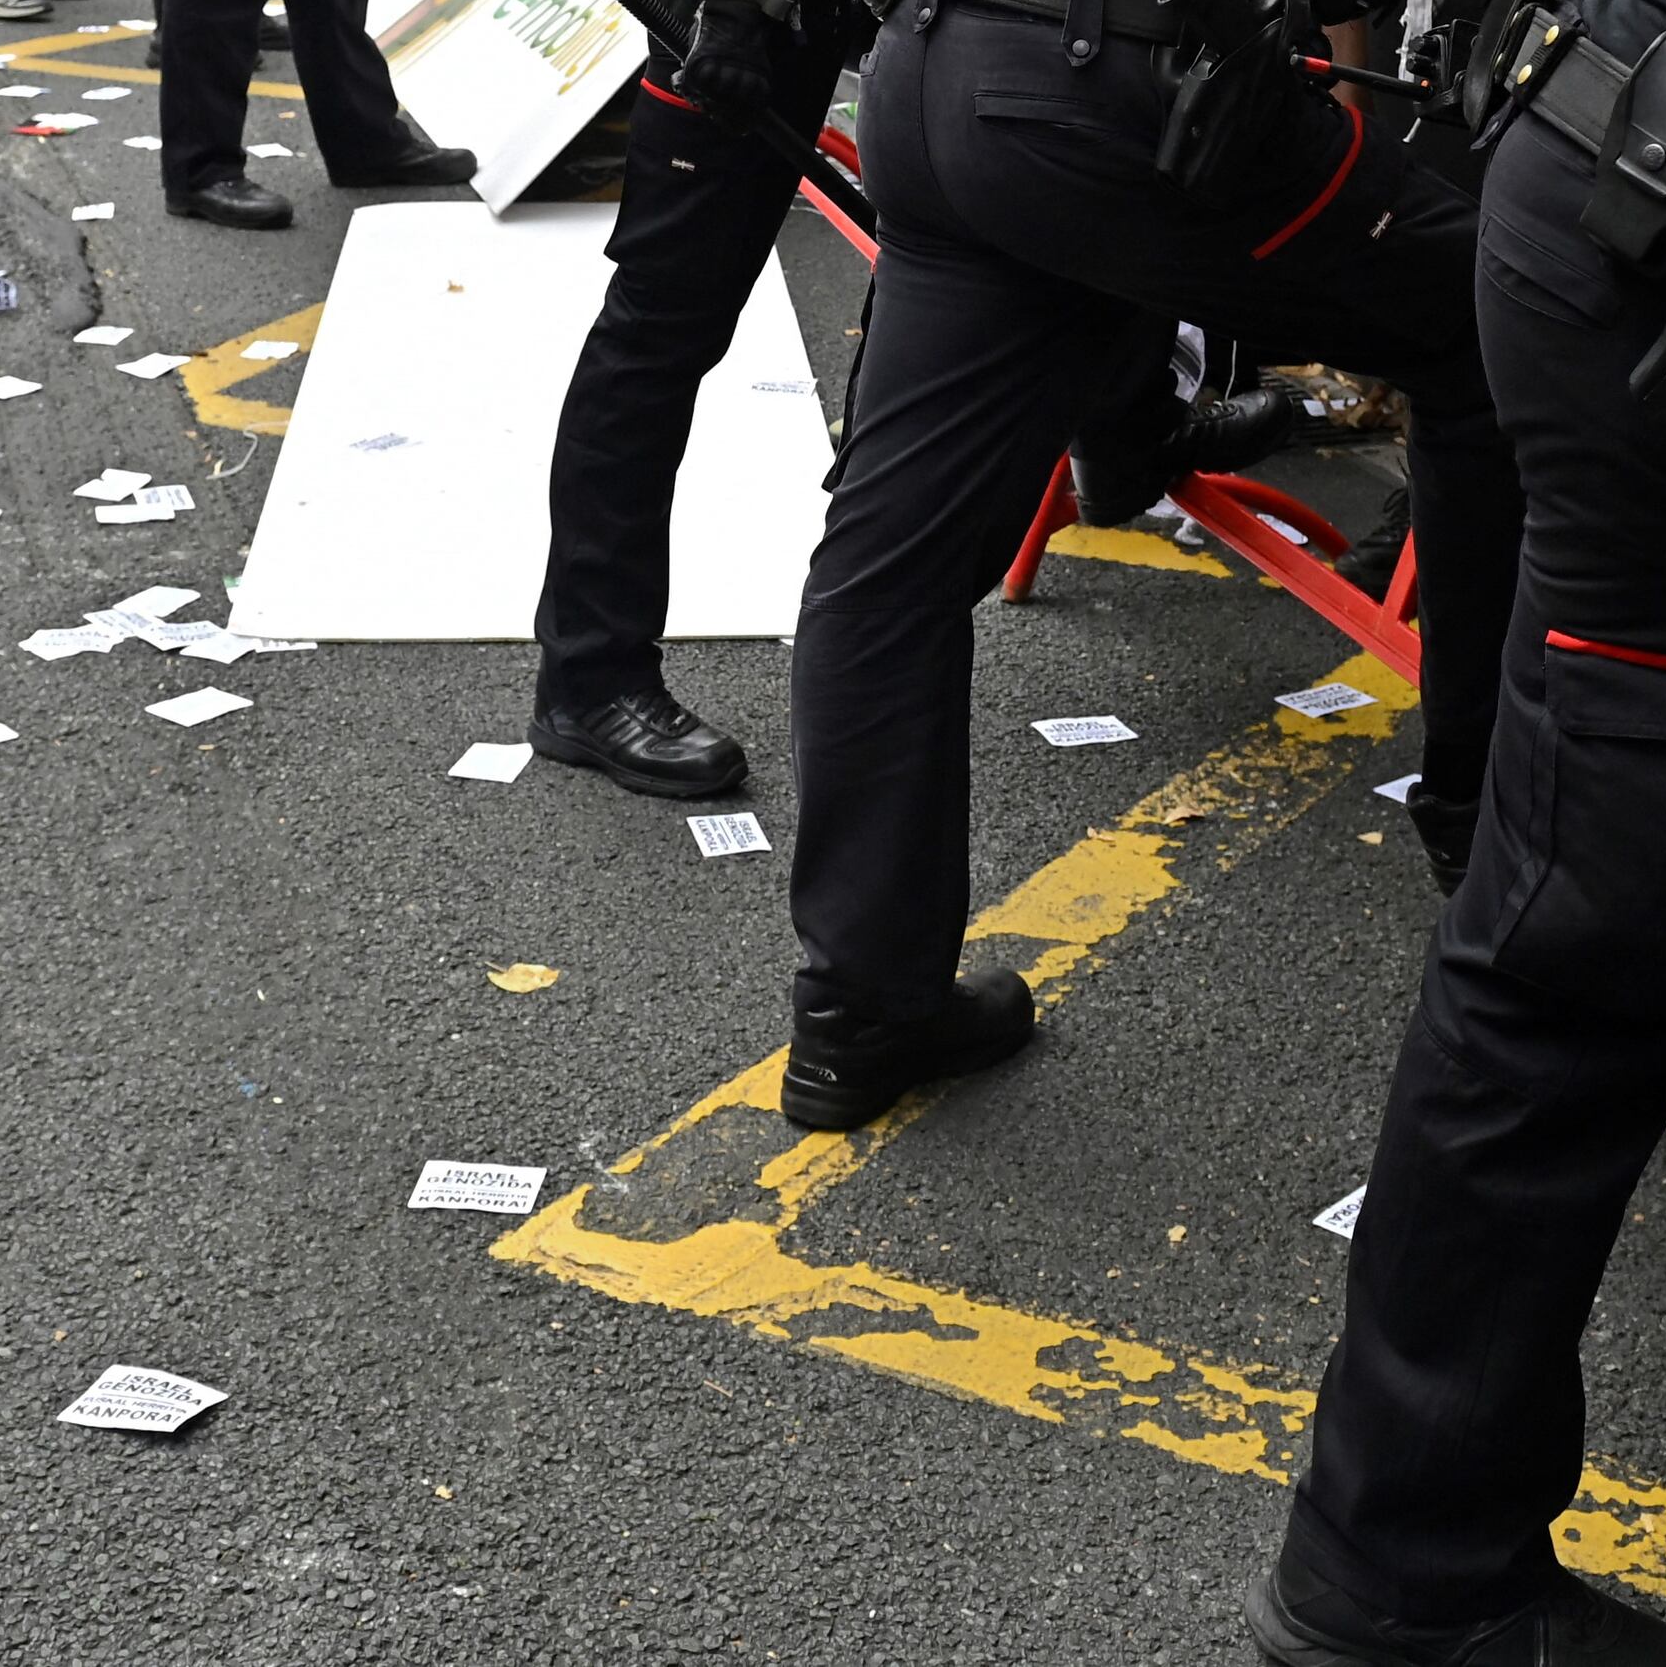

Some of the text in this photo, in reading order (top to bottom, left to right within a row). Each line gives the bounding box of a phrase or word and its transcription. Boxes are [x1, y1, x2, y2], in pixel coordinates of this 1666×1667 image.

[98, 1382, 203, 1406] GENOZIDA
[121, 1374, 194, 1396] ISRAEL
[72, 1404, 182, 1423] KANPORA!
